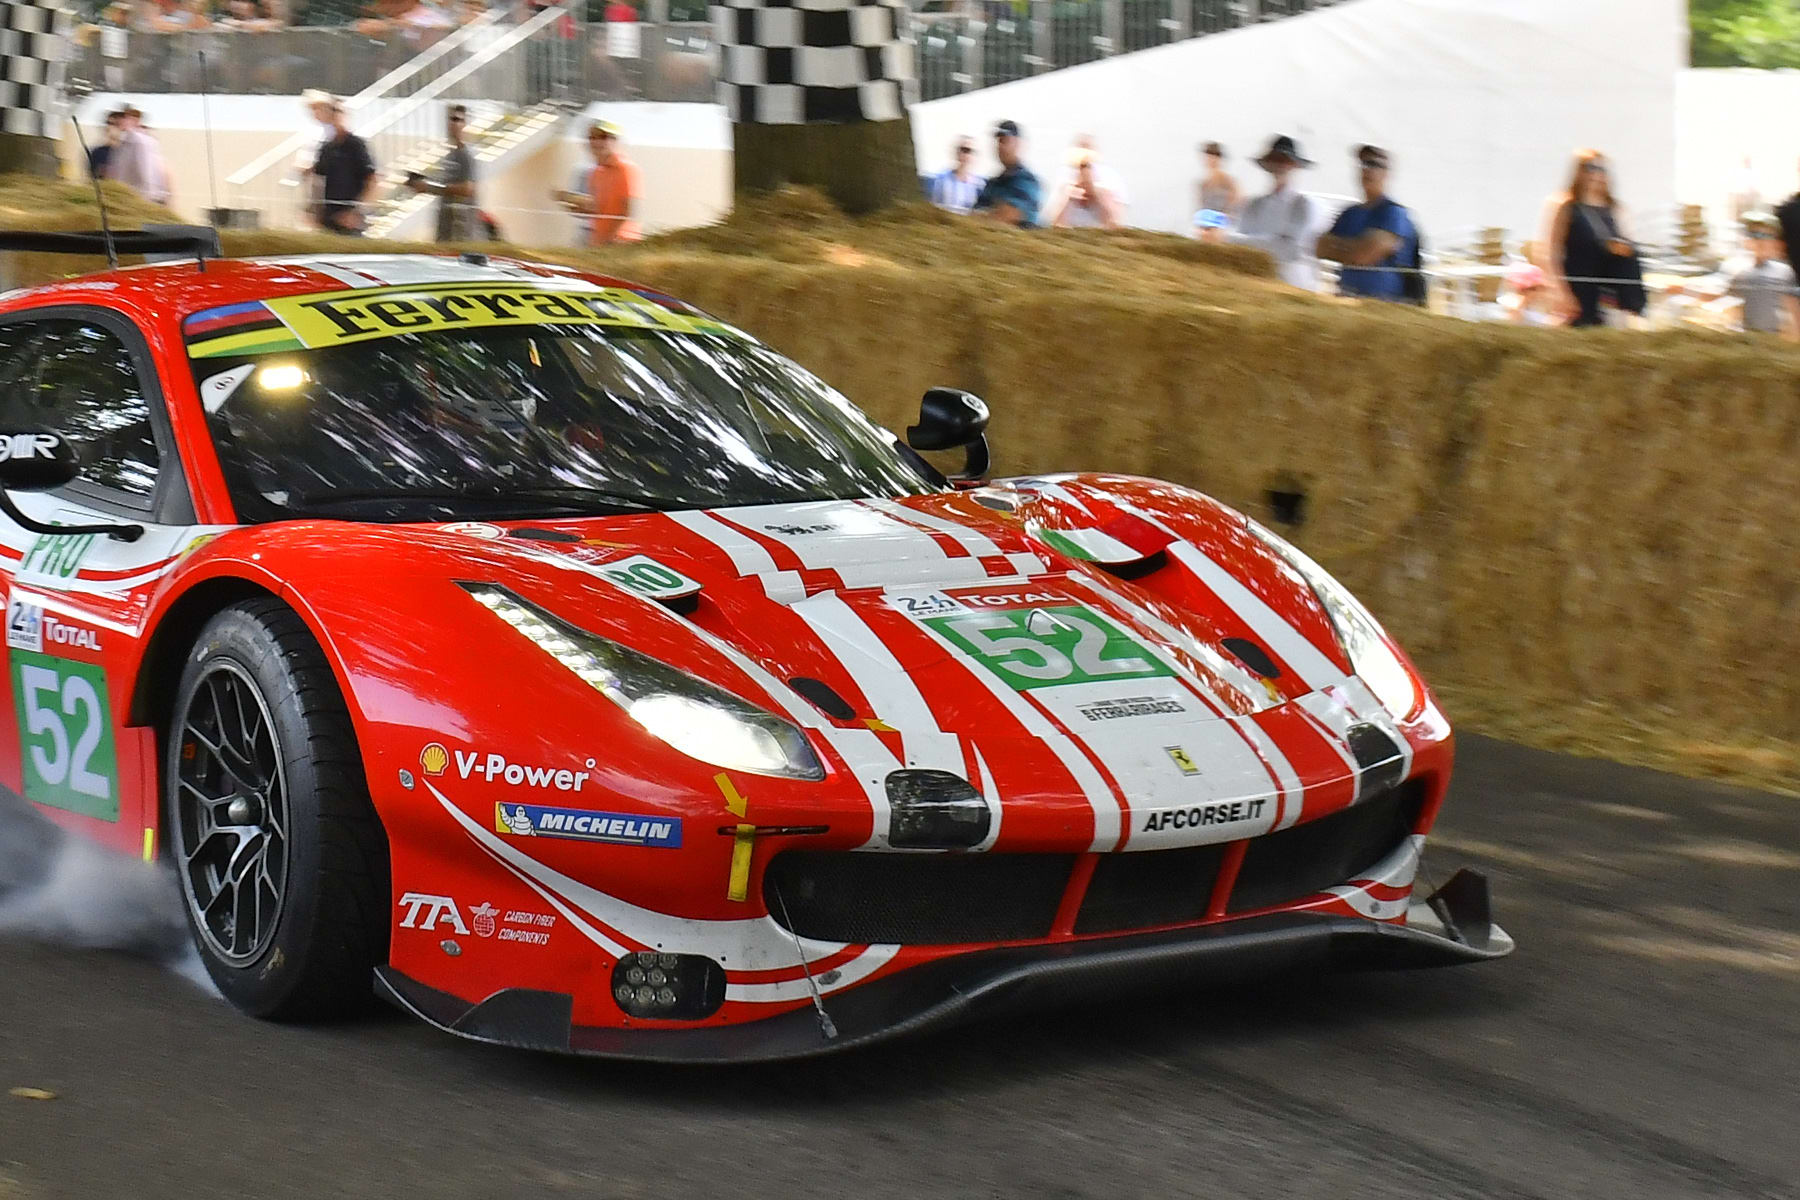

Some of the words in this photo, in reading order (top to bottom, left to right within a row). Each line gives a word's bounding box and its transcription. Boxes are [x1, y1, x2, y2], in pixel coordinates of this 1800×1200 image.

[300, 291, 669, 339] Ferrari
[956, 591, 1068, 607] TOTAL
[42, 616, 103, 651] TOTAL
[944, 613, 1156, 680] 52
[20, 663, 111, 799] 52
[454, 749, 590, 792] V-Power
[538, 812, 673, 840] MICHELIN
[1142, 799, 1267, 833] AFCORSE.IT
